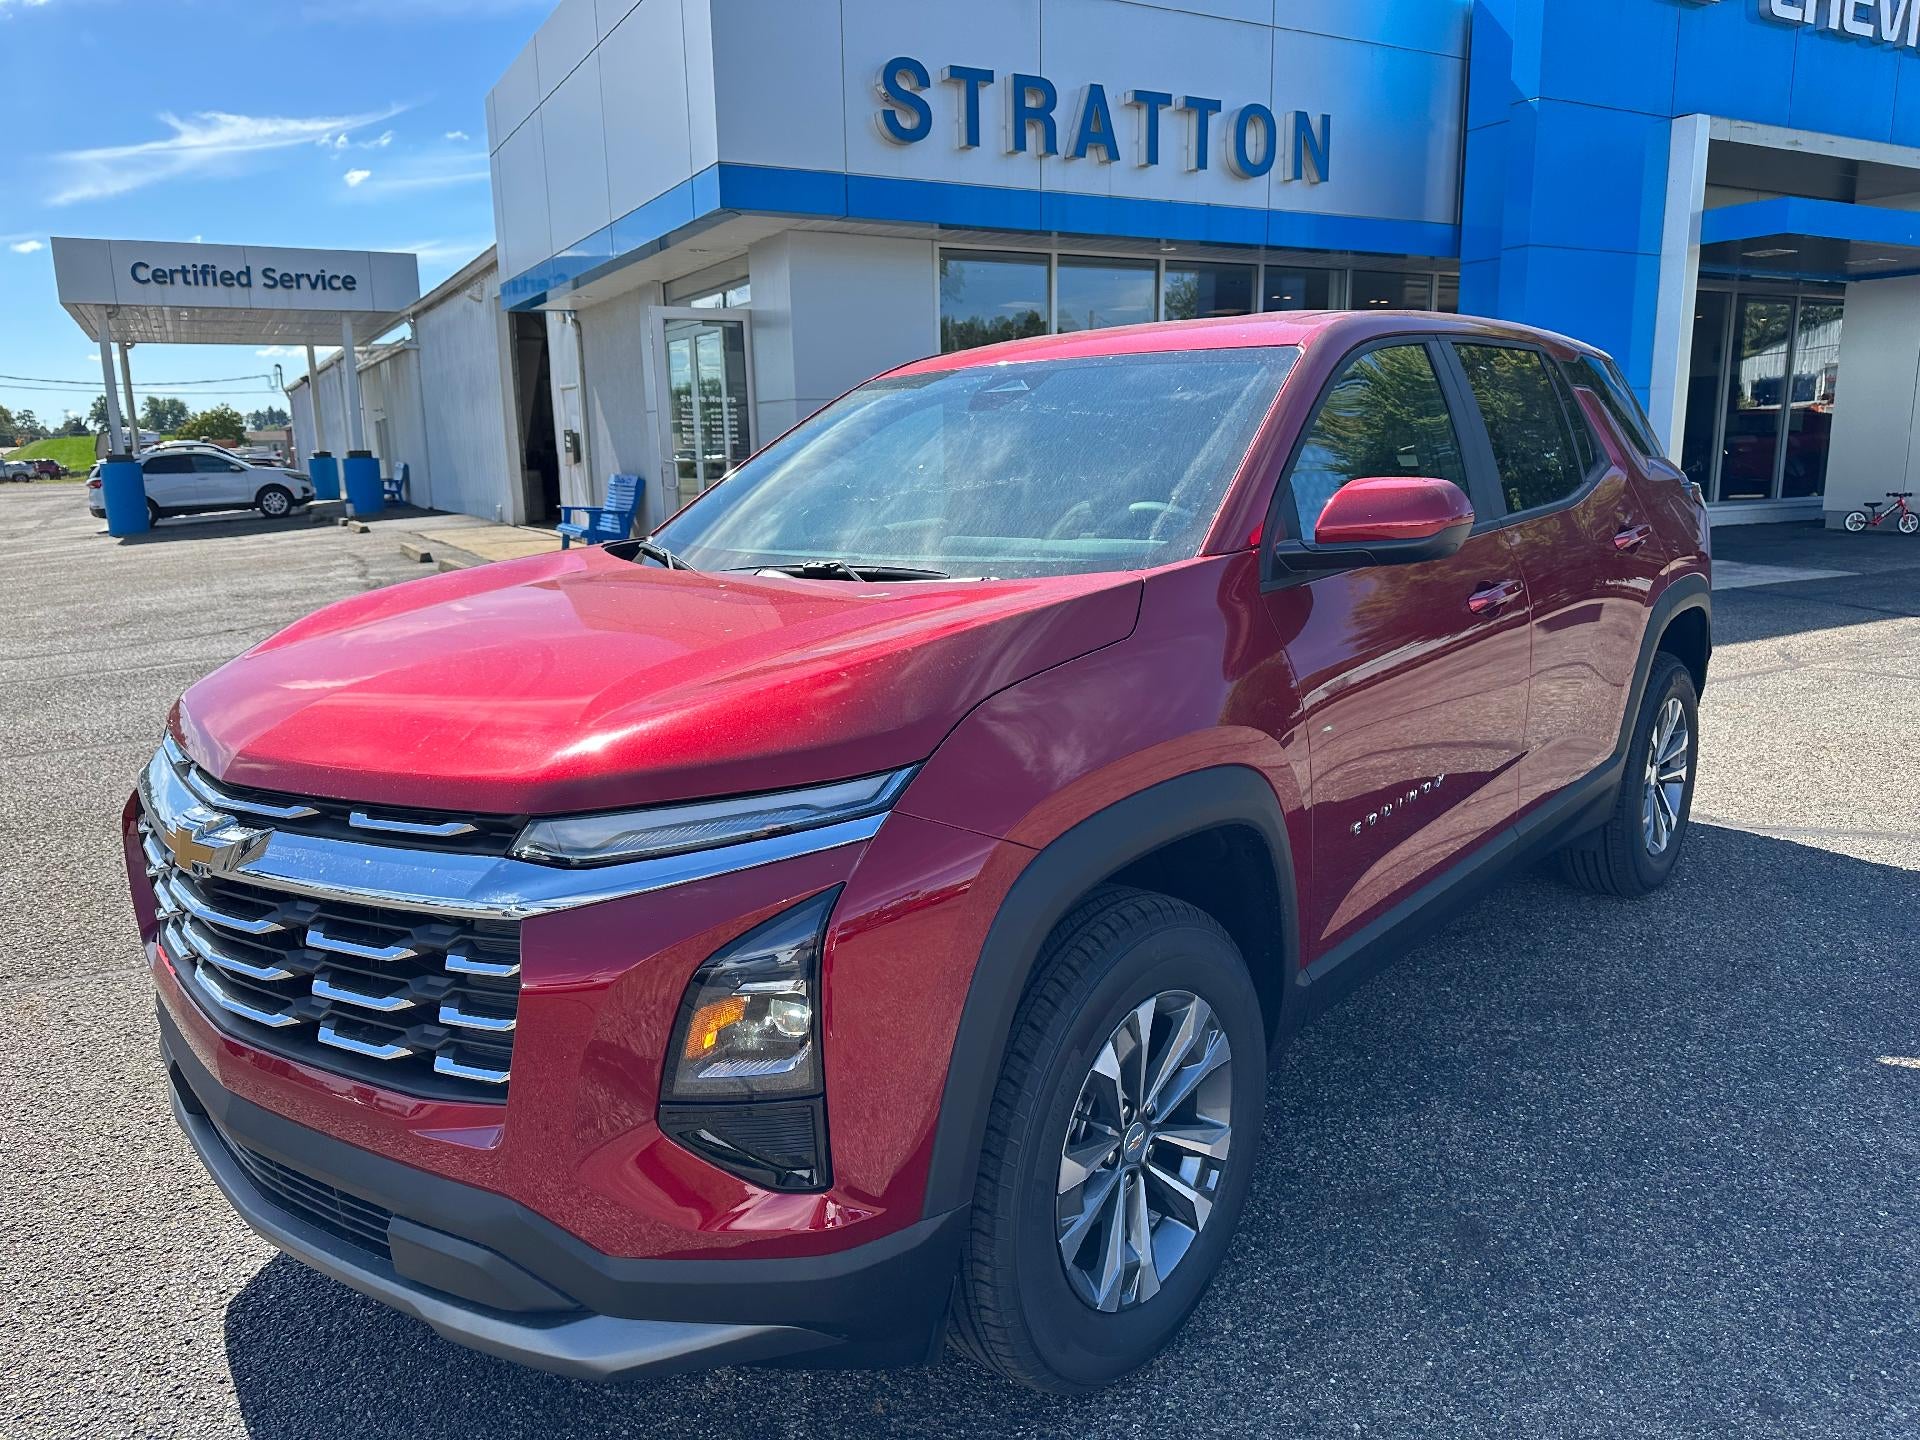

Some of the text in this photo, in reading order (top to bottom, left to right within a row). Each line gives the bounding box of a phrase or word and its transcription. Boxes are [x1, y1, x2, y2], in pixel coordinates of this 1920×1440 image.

[874, 56, 1331, 184] STRATTON
[130, 261, 357, 291] Certified Service
